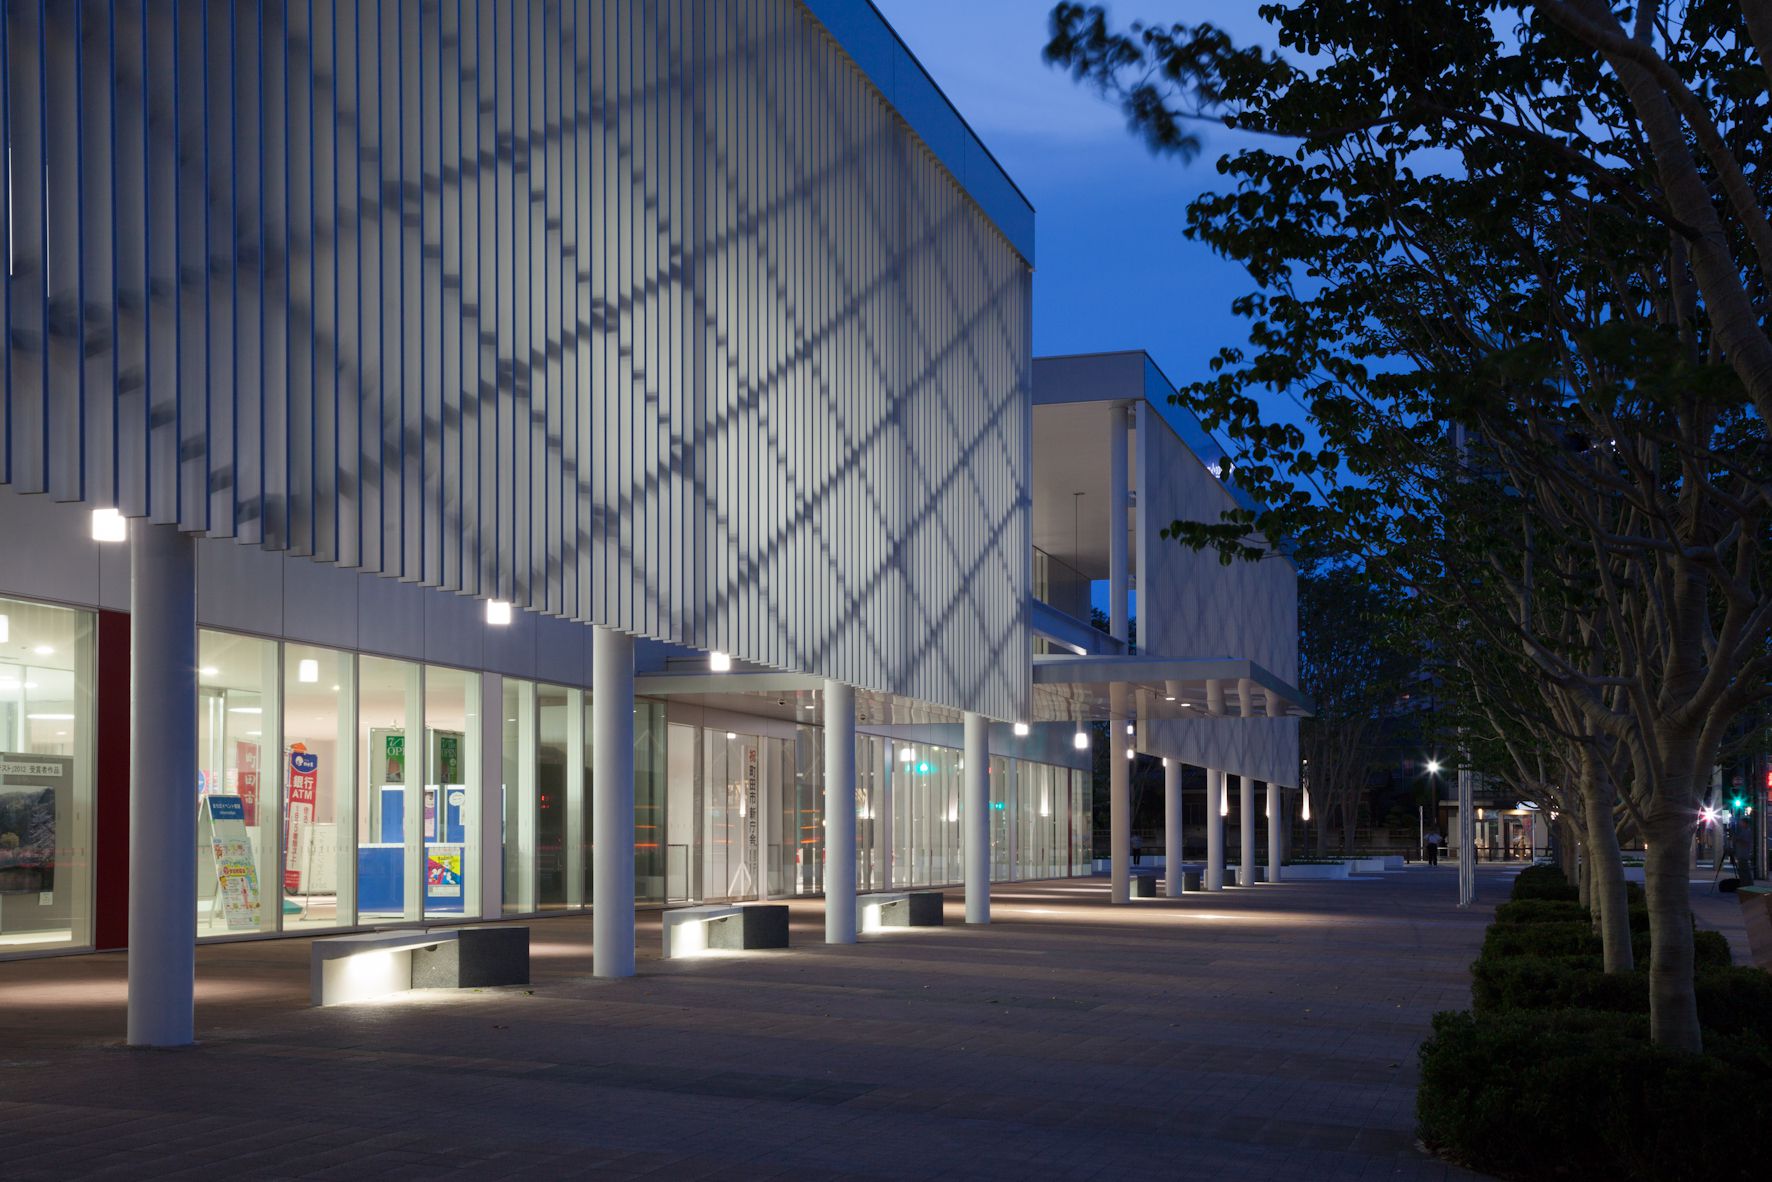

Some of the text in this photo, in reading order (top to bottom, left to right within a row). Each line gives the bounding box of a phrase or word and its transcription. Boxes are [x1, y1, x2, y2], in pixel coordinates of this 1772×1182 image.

[387, 747, 405, 756] OP
[293, 775, 314, 790] 銀行
[292, 789, 313, 801] ATM
